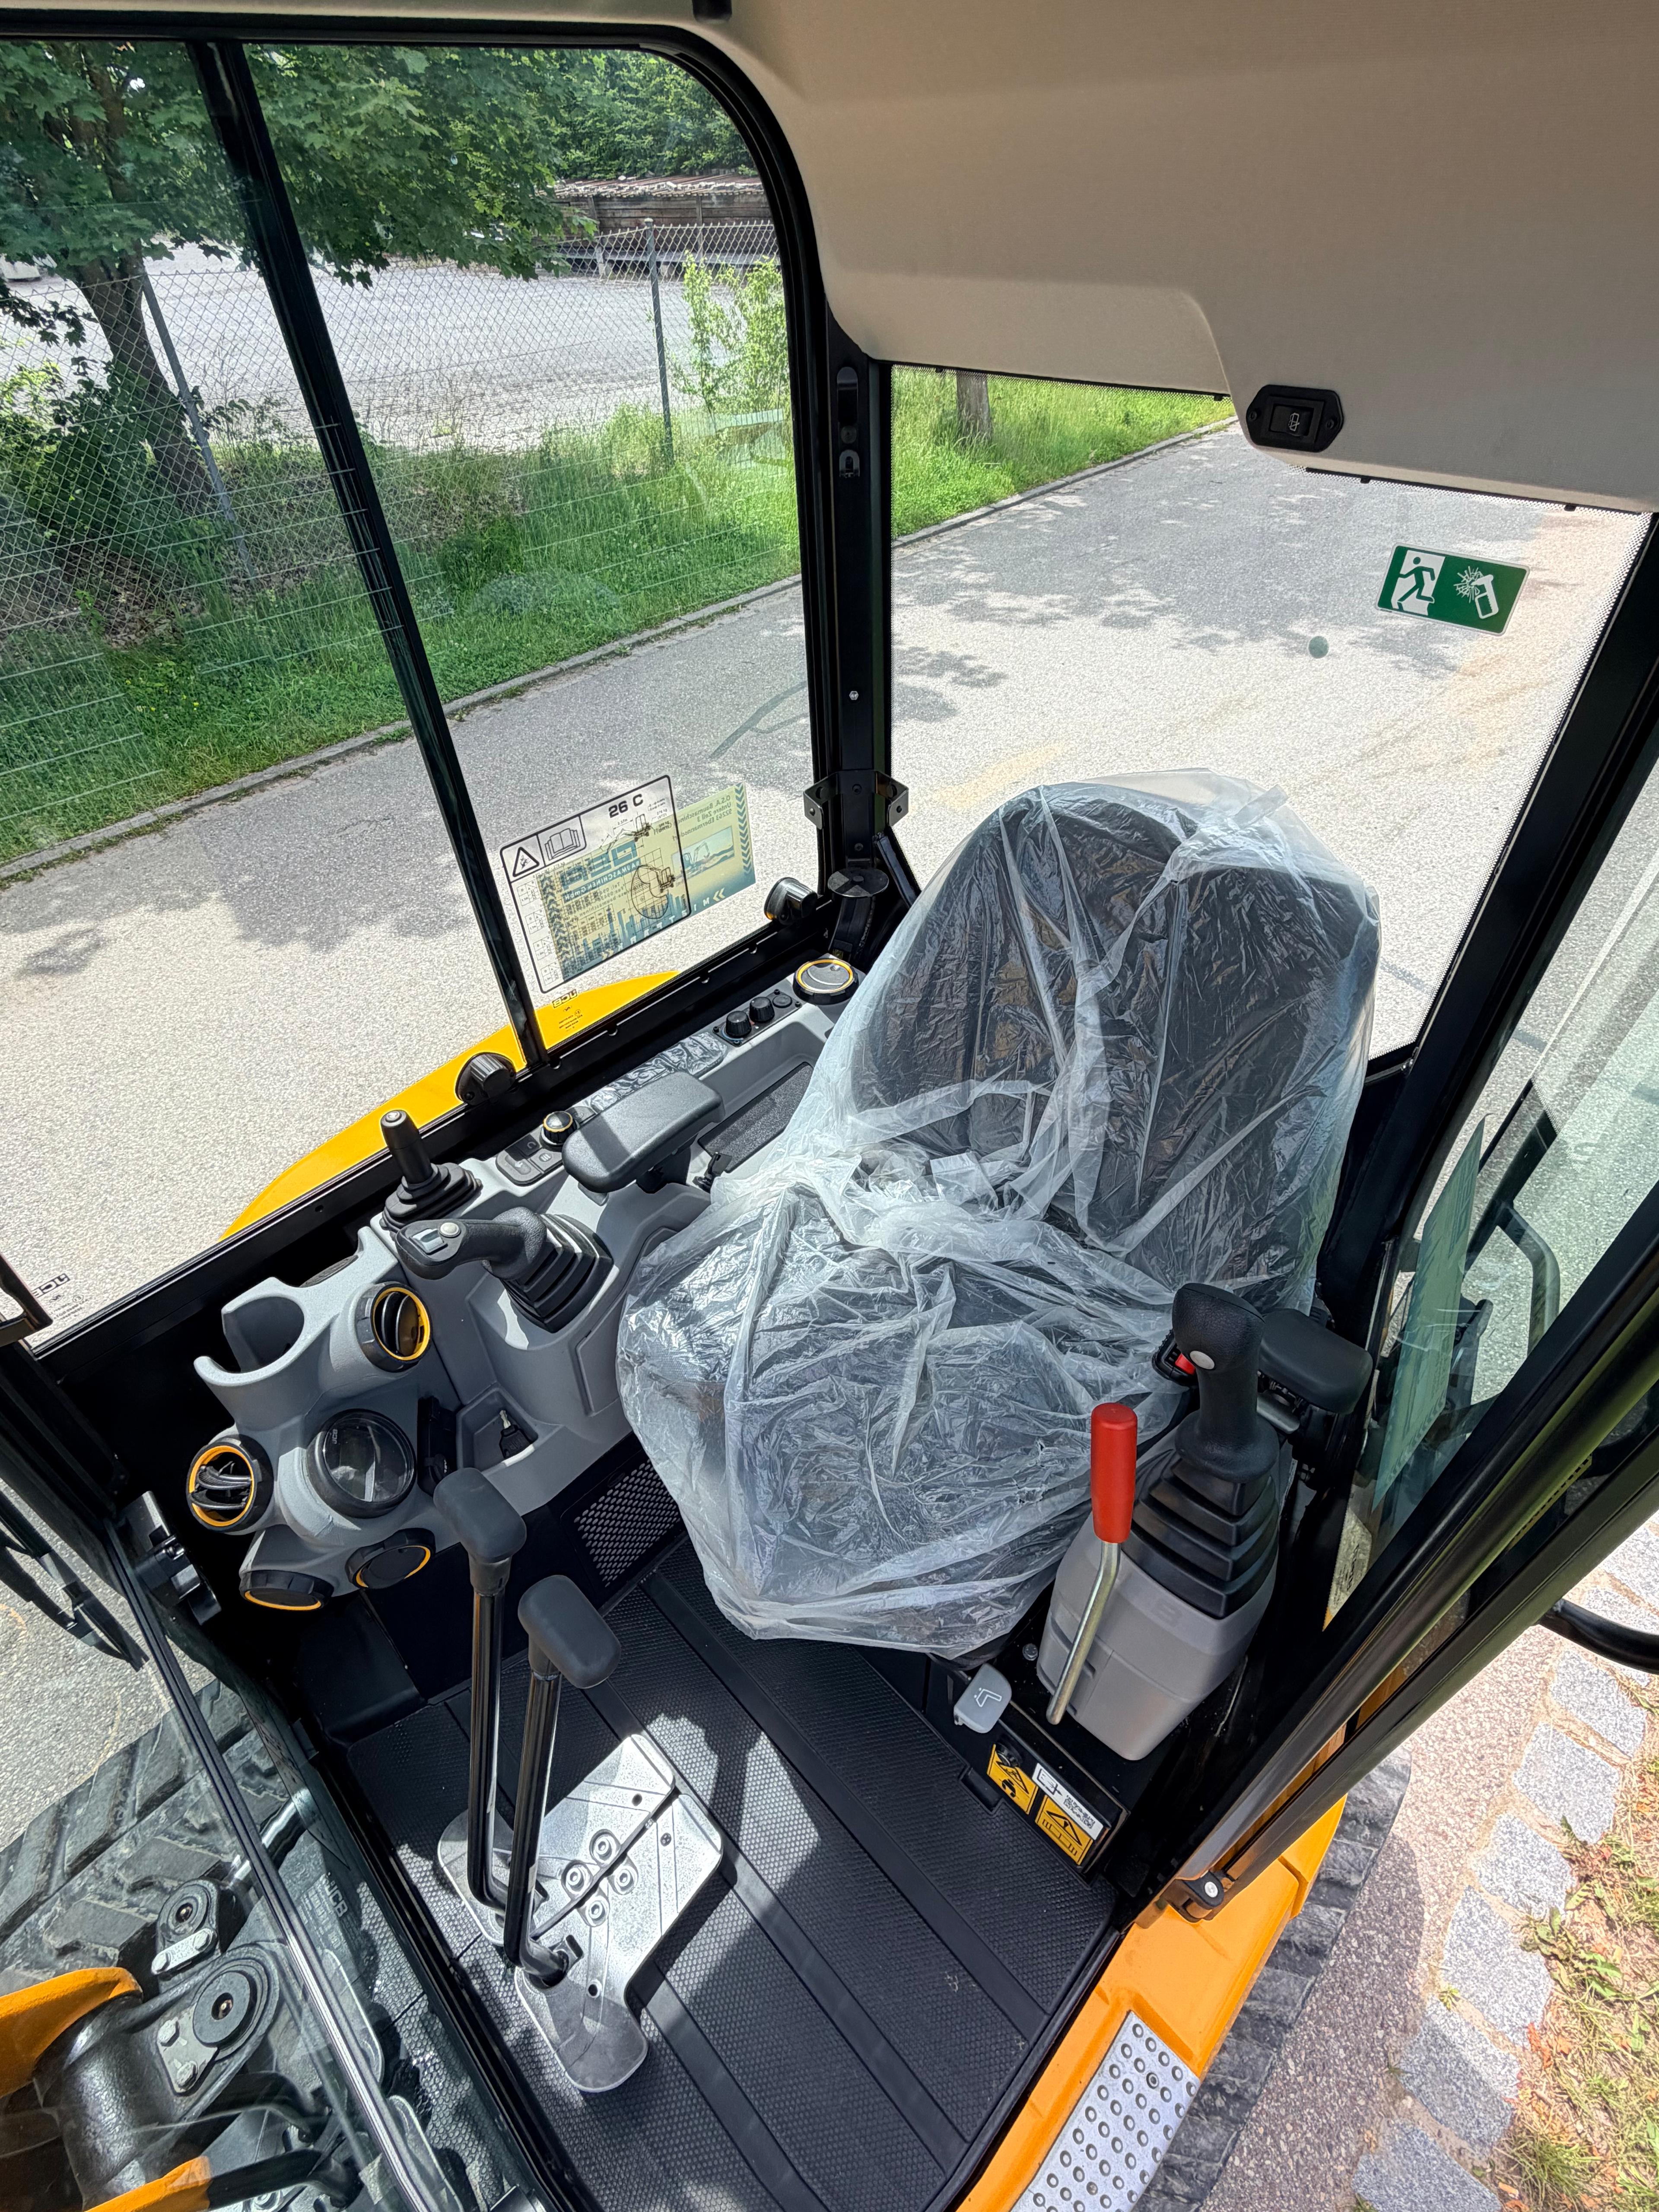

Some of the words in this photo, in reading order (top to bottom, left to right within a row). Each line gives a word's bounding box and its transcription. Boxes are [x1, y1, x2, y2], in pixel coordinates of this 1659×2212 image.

[608, 801, 629, 818] 26
[633, 793, 644, 807] C
[324, 1880, 348, 1918] JCB
